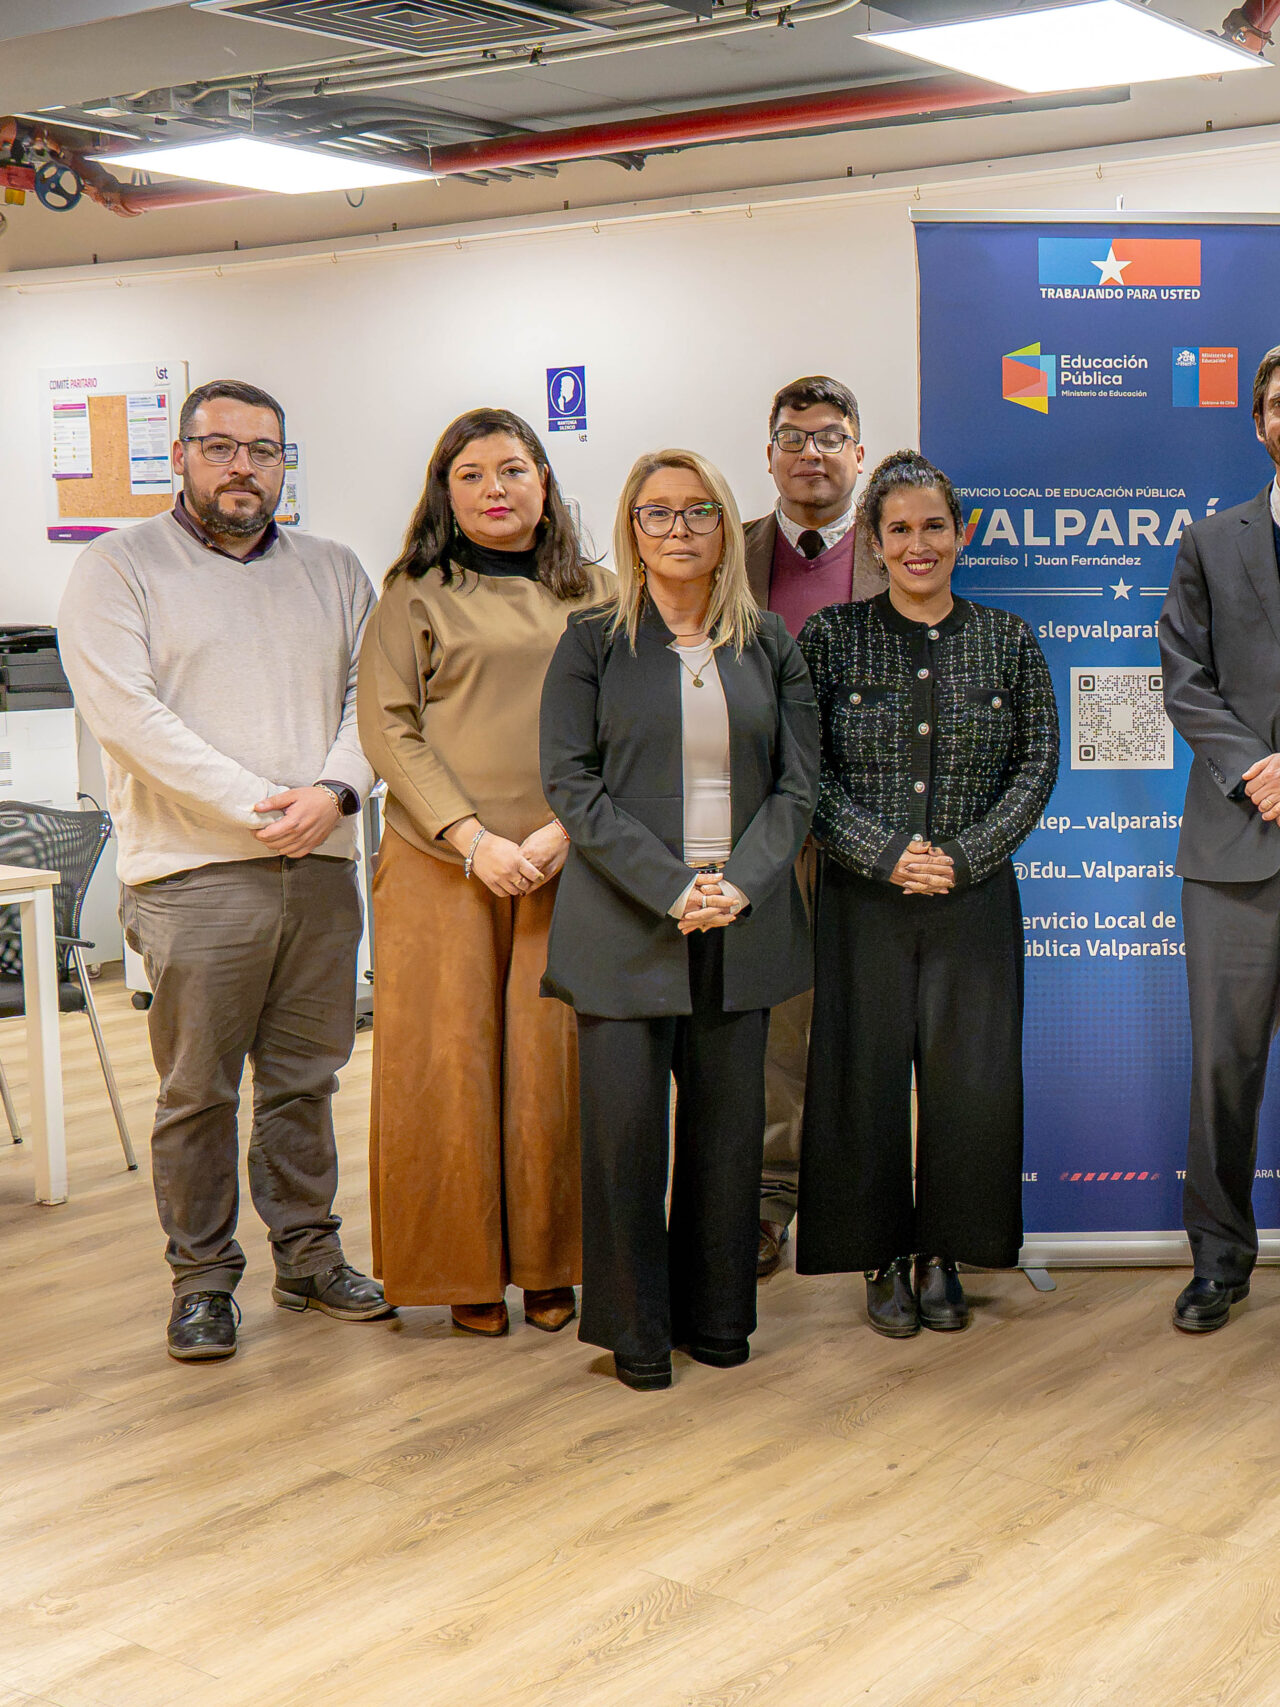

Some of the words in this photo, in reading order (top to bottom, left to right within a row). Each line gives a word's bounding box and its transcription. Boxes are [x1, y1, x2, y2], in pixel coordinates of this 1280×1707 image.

[1040, 288, 1124, 299] TRABAJANDO
[1126, 288, 1158, 300] PARA
[1160, 289, 1201, 300] USTED
[1061, 353, 1149, 369] Educación
[1061, 371, 1123, 386] Pública
[953, 488, 1001, 497] ERVICIO
[1003, 488, 1043, 498] LOCAL
[1045, 488, 1061, 498] DE
[1063, 486, 1133, 498] EDUCACIÓN
[1136, 485, 1186, 498] PÚBLICA
[1034, 554, 1068, 566] Juan
[1071, 554, 1142, 566] Fernández
[1038, 620, 1160, 642] slepvalparai
[1036, 812, 1183, 833] lep_valparais
[1013, 861, 1177, 882] @Edu_Valparais
[1023, 911, 1089, 929] ervicio
[1094, 911, 1147, 929] Local
[1152, 911, 1176, 929] de
[1024, 939, 1081, 957] ública
[1022, 1172, 1038, 1181] ILE
[1254, 1169, 1274, 1179] ARA
